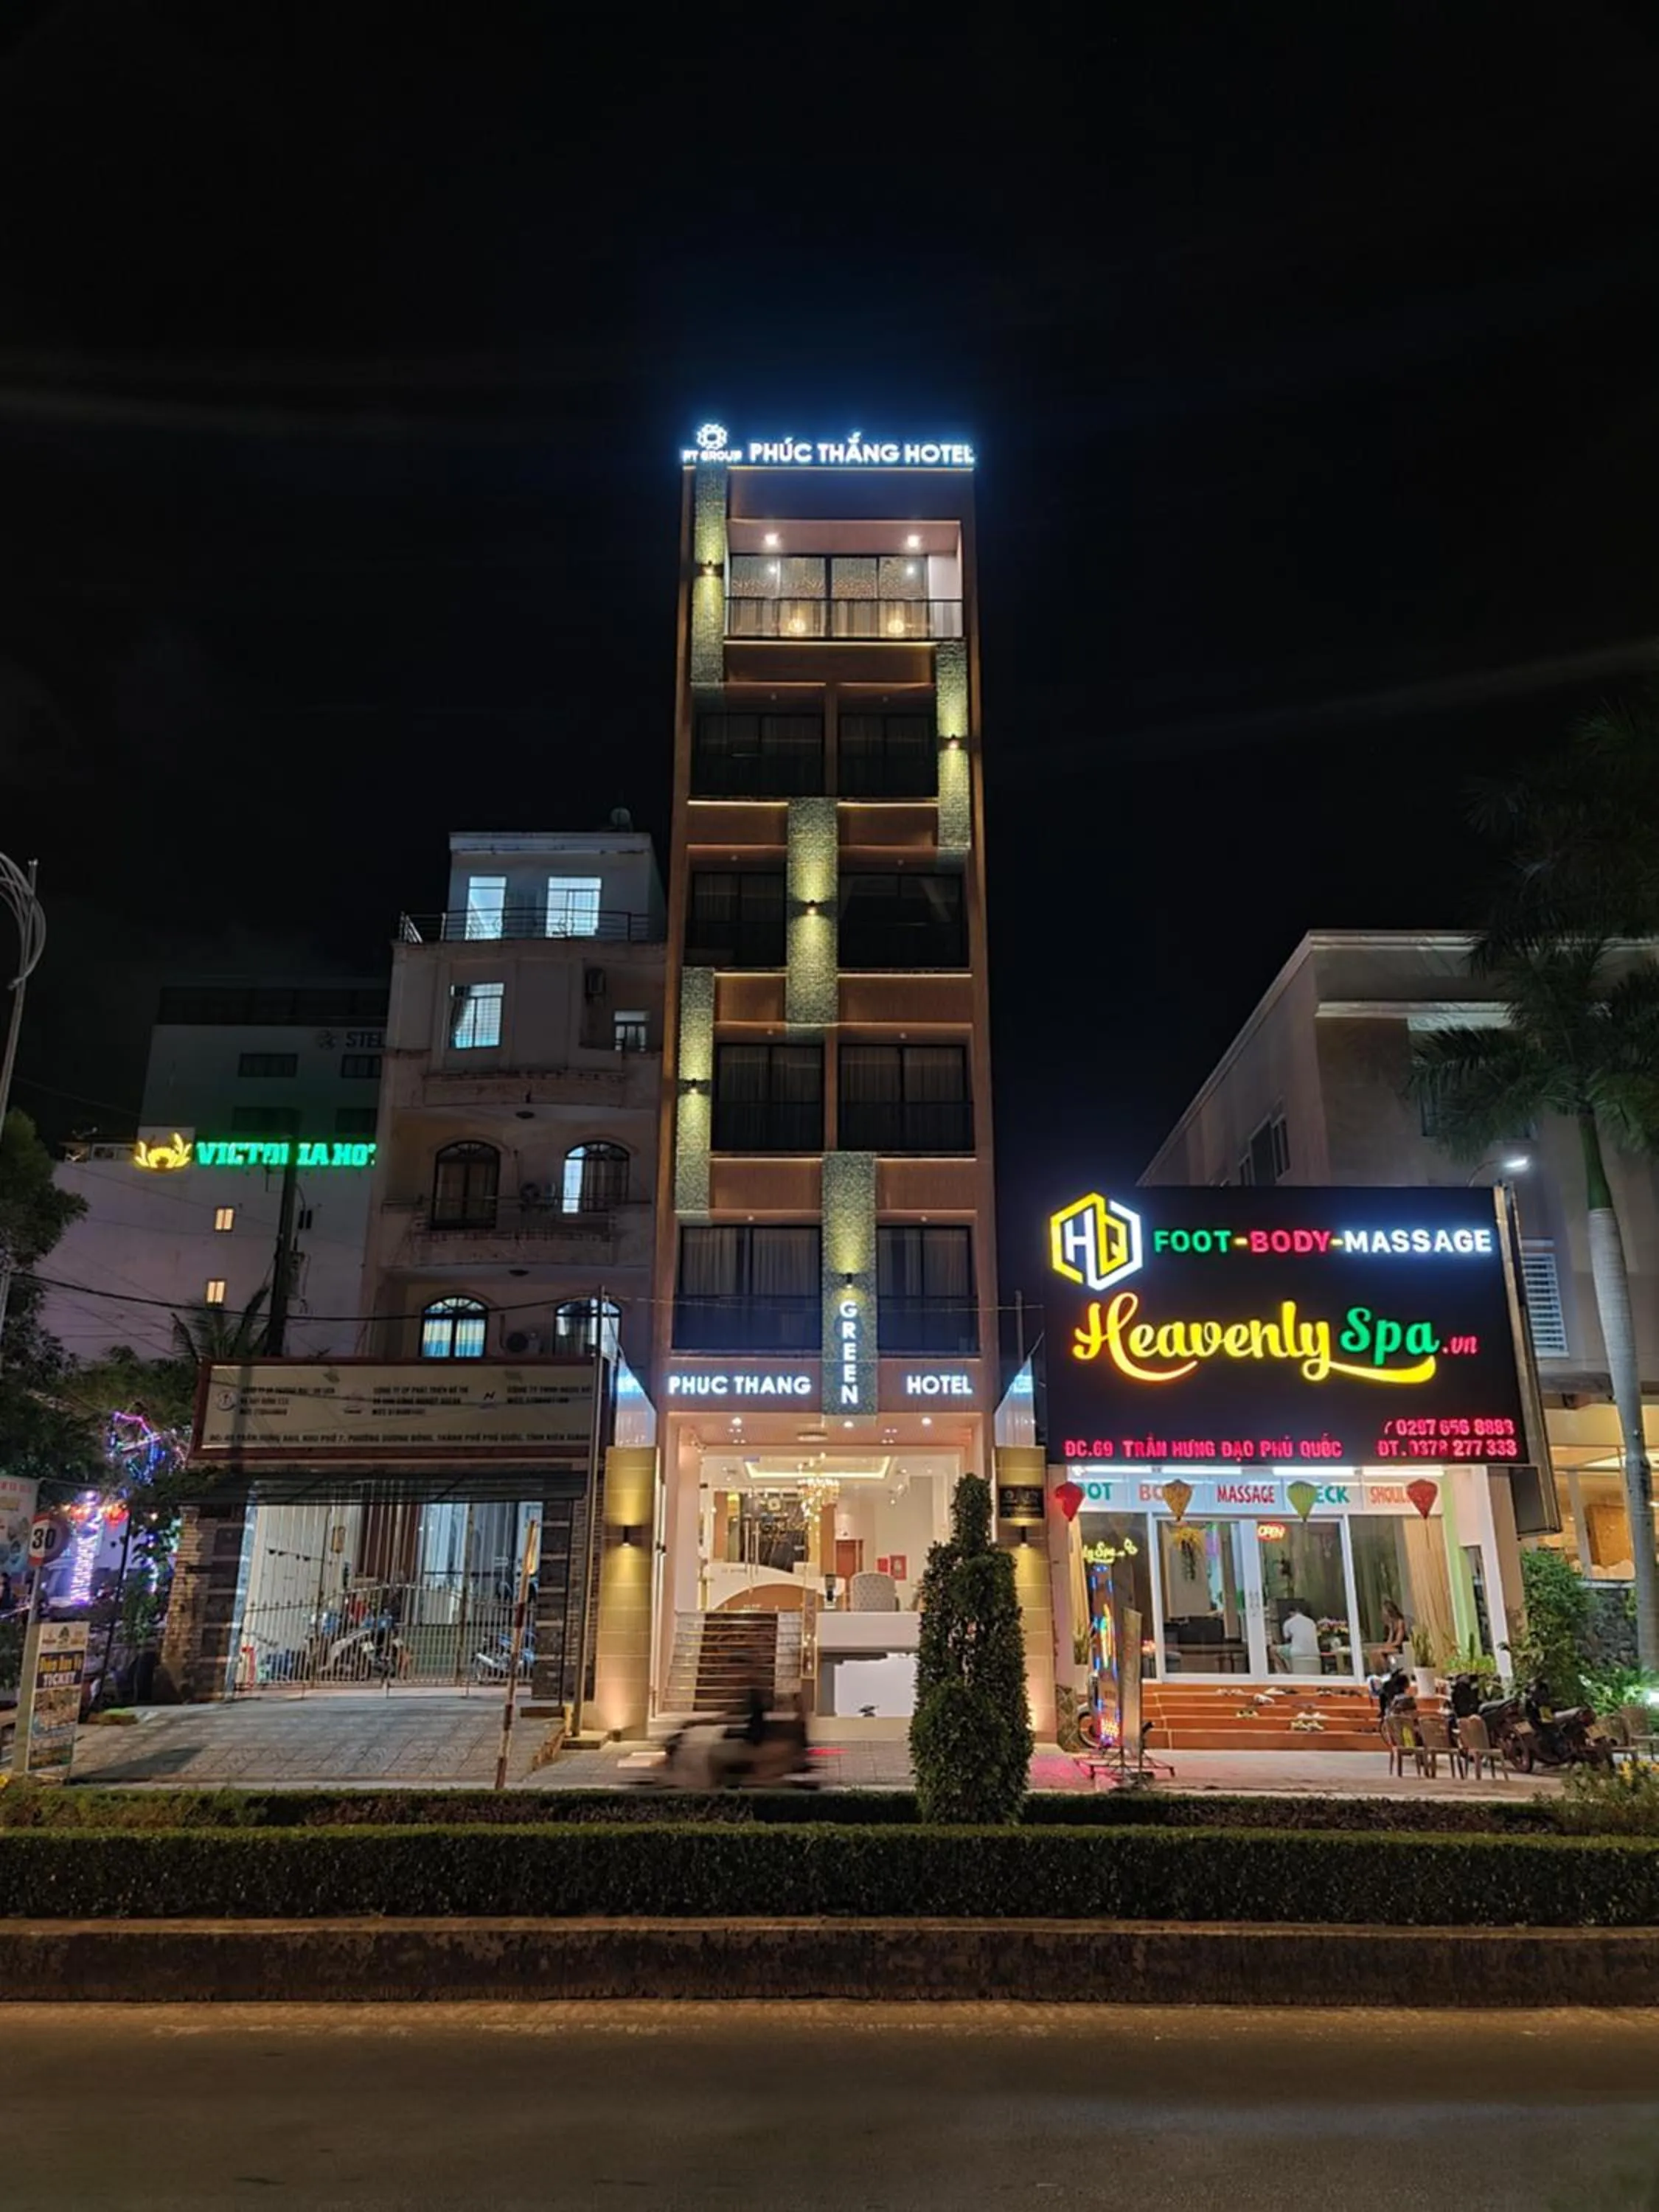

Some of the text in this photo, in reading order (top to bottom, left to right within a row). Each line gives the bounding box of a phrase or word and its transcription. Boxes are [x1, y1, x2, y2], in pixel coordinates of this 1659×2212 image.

[749, 431, 974, 463] PHÚC THẮNG HOTEL
[1072, 1293, 1332, 1381] Heavenly
[838, 1301, 859, 1404] GREEN
[668, 1375, 973, 1395] PHUC THANG HOTEL
[1396, 1419, 1436, 1436] 0297
[1452, 1439, 1483, 1457] 277
[1486, 1439, 1517, 1457] 333
[1217, 1486, 1275, 1503] MASSAGE
[1312, 1485, 1350, 1503] ECK
[32, 1528, 56, 1550] 30
